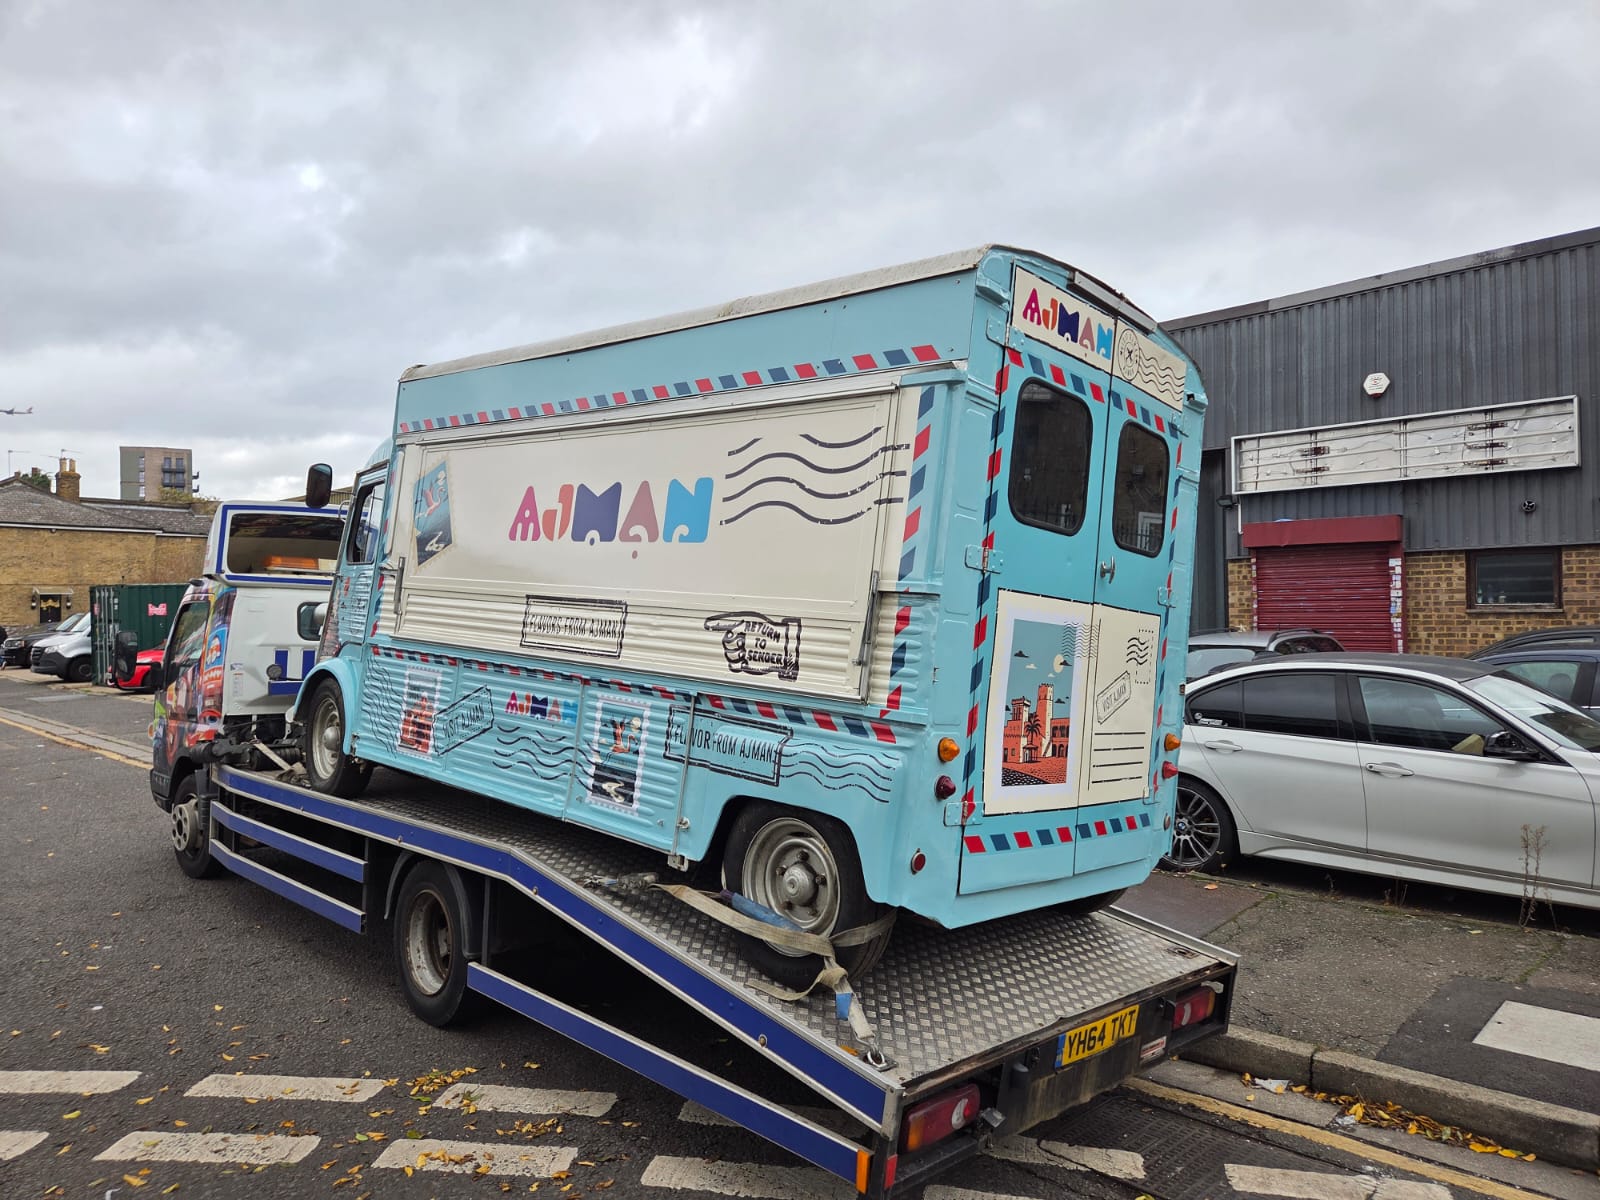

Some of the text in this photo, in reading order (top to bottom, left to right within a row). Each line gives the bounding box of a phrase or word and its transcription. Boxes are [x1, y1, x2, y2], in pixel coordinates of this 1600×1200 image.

[1023, 288, 1113, 360] AJMAN
[509, 477, 714, 544] AJMAN
[529, 614, 618, 639] FLAVORS FROM AJMAN
[744, 621, 780, 643] RETURN
[747, 650, 783, 665] SENDER
[755, 638, 767, 649] TO
[462, 703, 484, 730] AJMAN
[505, 691, 577, 725] AJMAN
[712, 732, 738, 757] FROM
[740, 738, 774, 763] AJMAN
[1068, 1022, 1106, 1059] YH64
[1112, 1009, 1136, 1041] TKT
